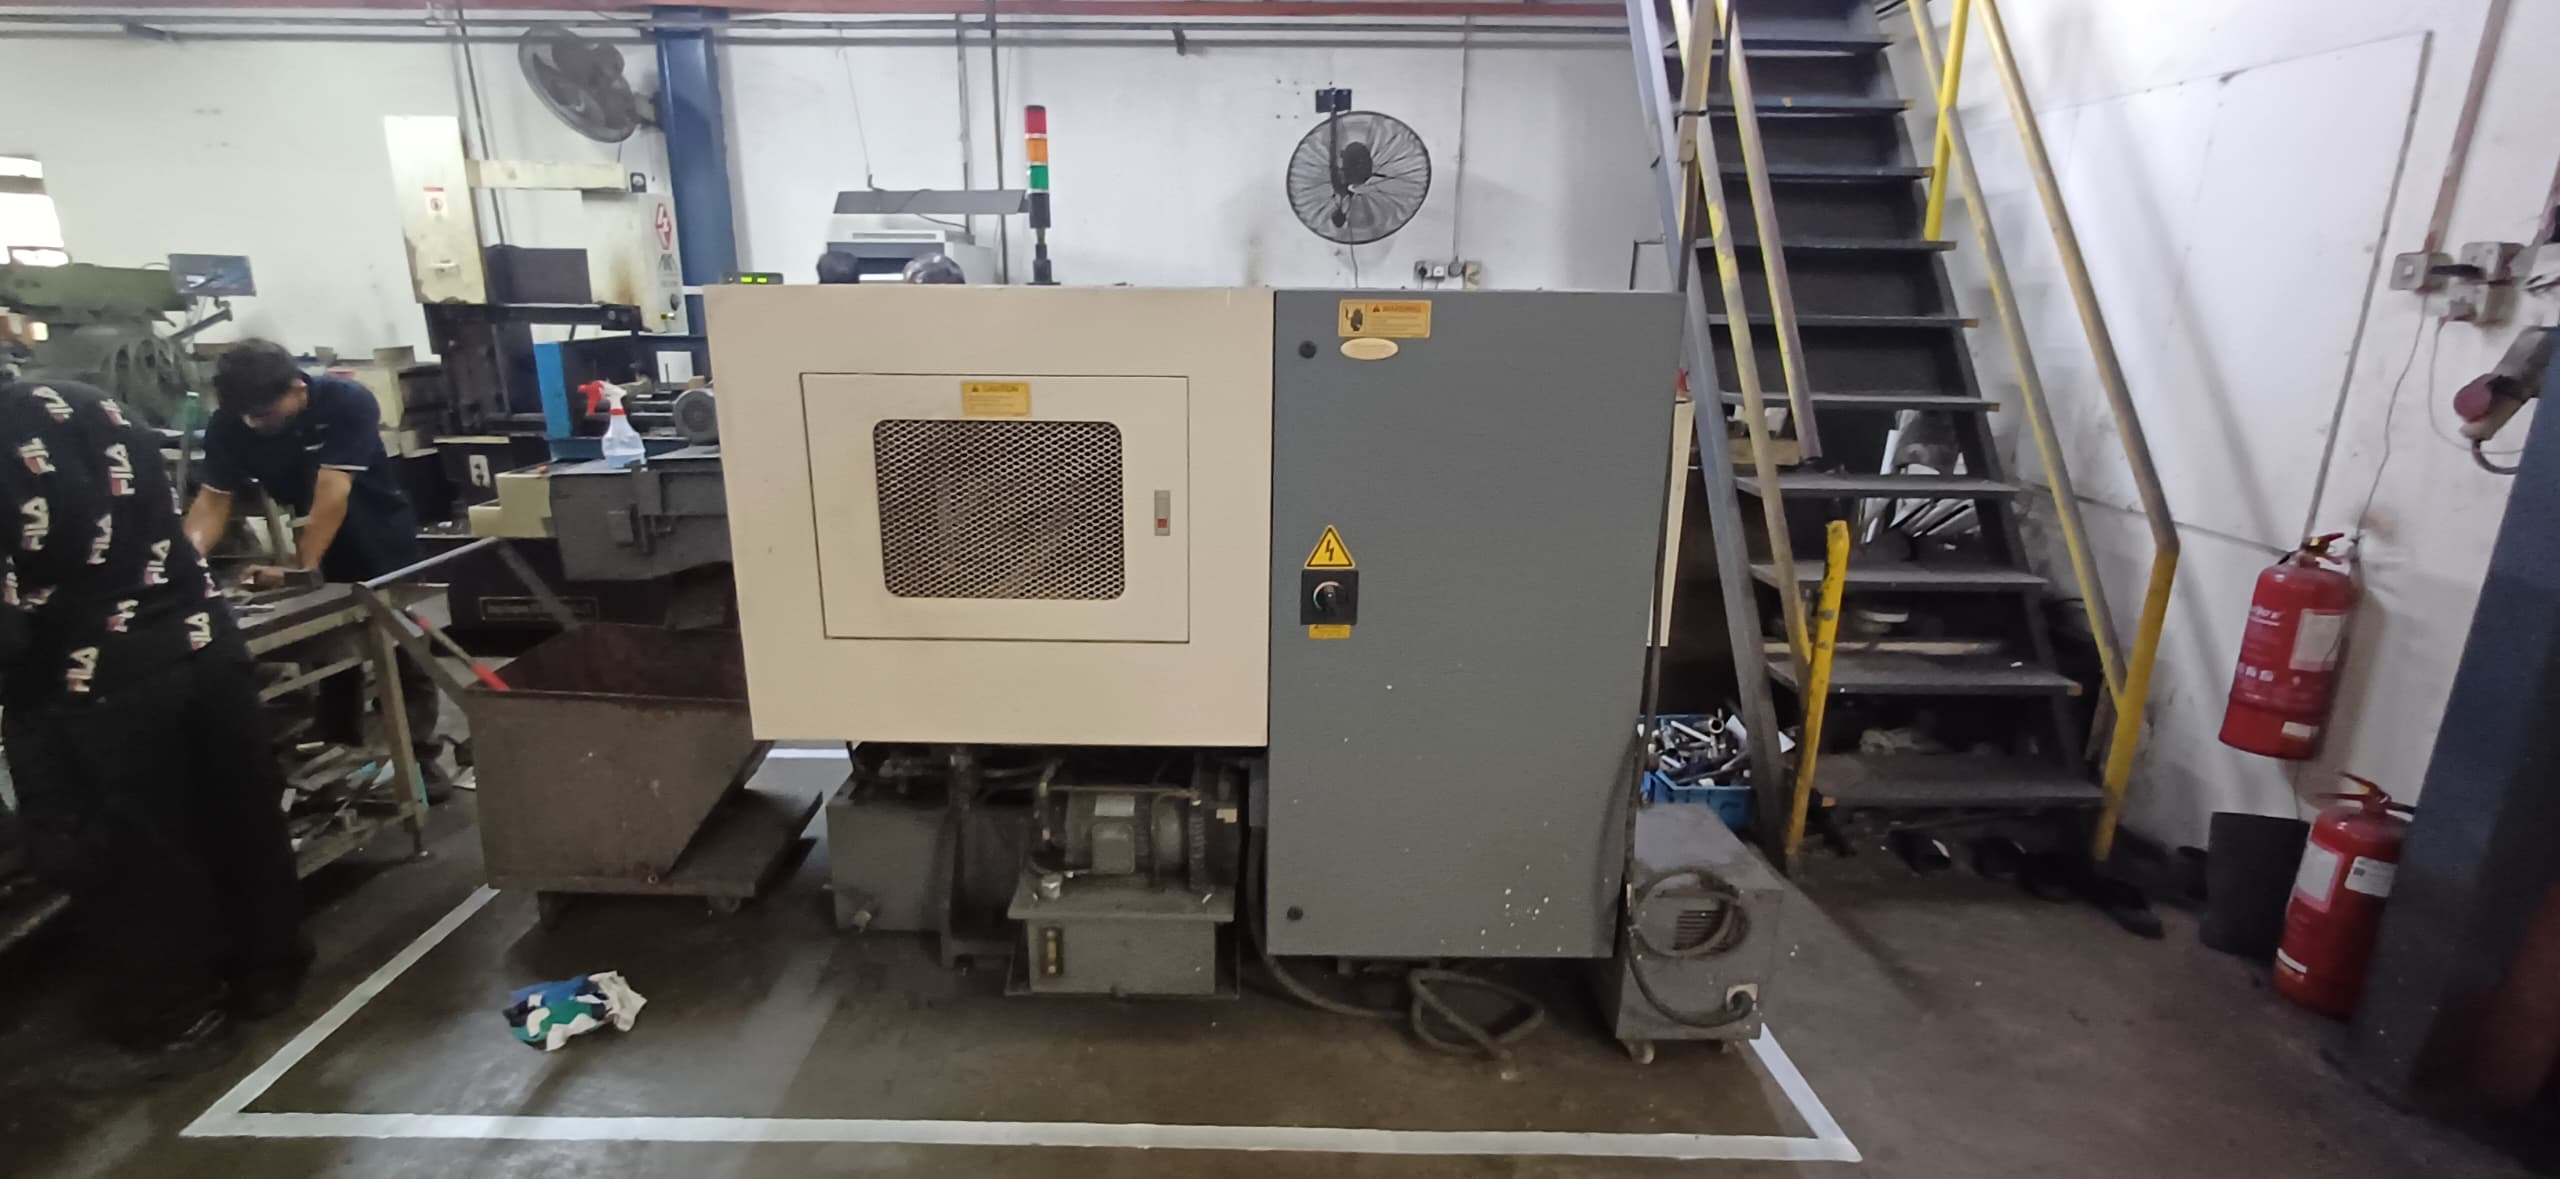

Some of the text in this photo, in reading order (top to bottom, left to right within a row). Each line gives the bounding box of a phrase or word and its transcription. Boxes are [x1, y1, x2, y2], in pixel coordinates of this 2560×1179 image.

[17, 437, 56, 475] FIL
[104, 443, 136, 497] FILA
[20, 495, 50, 551] FILA
[144, 539, 172, 586] FILA
[66, 646, 100, 693] FILA
